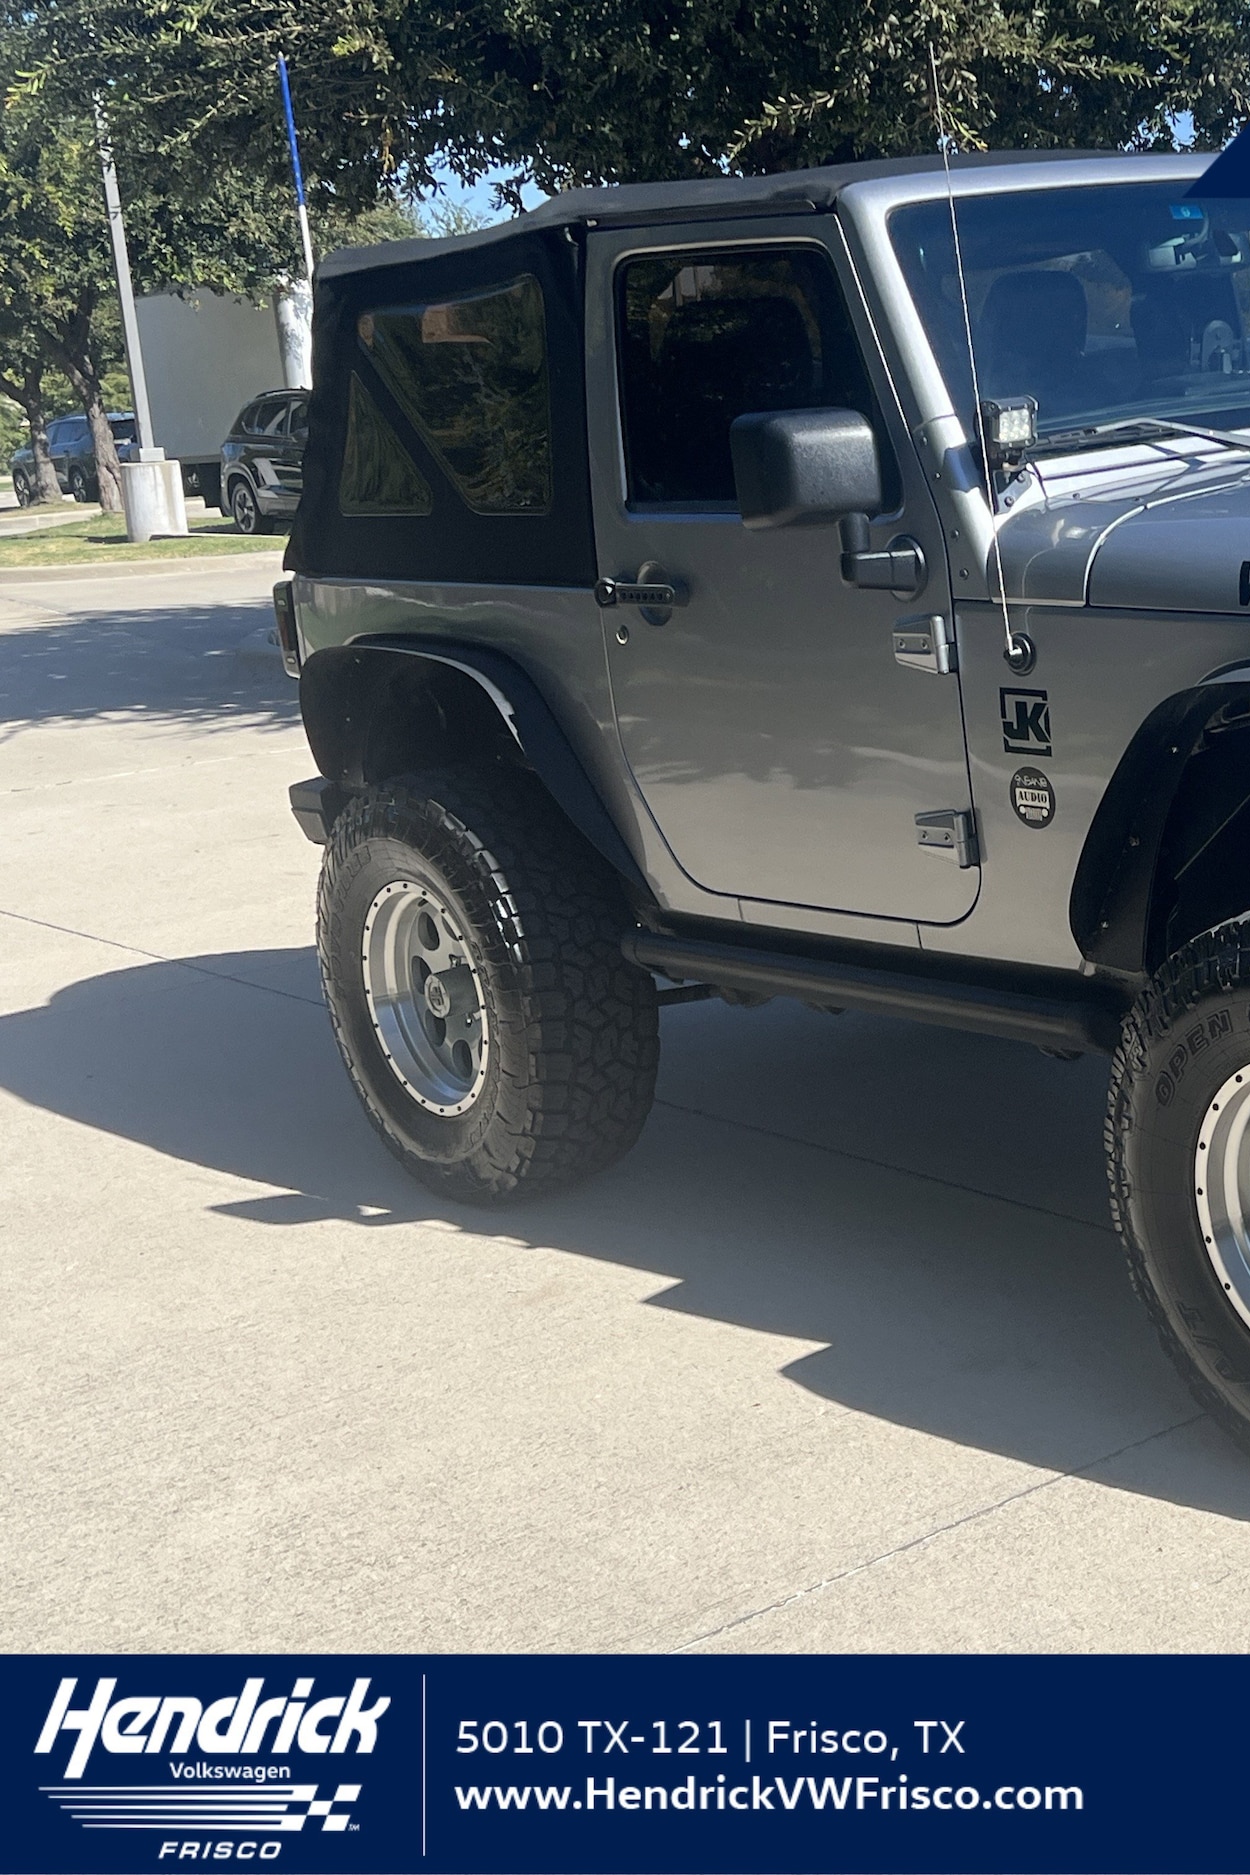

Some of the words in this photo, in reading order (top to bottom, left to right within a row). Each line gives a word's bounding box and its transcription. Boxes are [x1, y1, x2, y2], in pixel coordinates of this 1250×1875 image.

[1002, 701, 1051, 743] JK
[1018, 790, 1048, 804] AUDIO
[1155, 1010, 1233, 1106] OPEN
